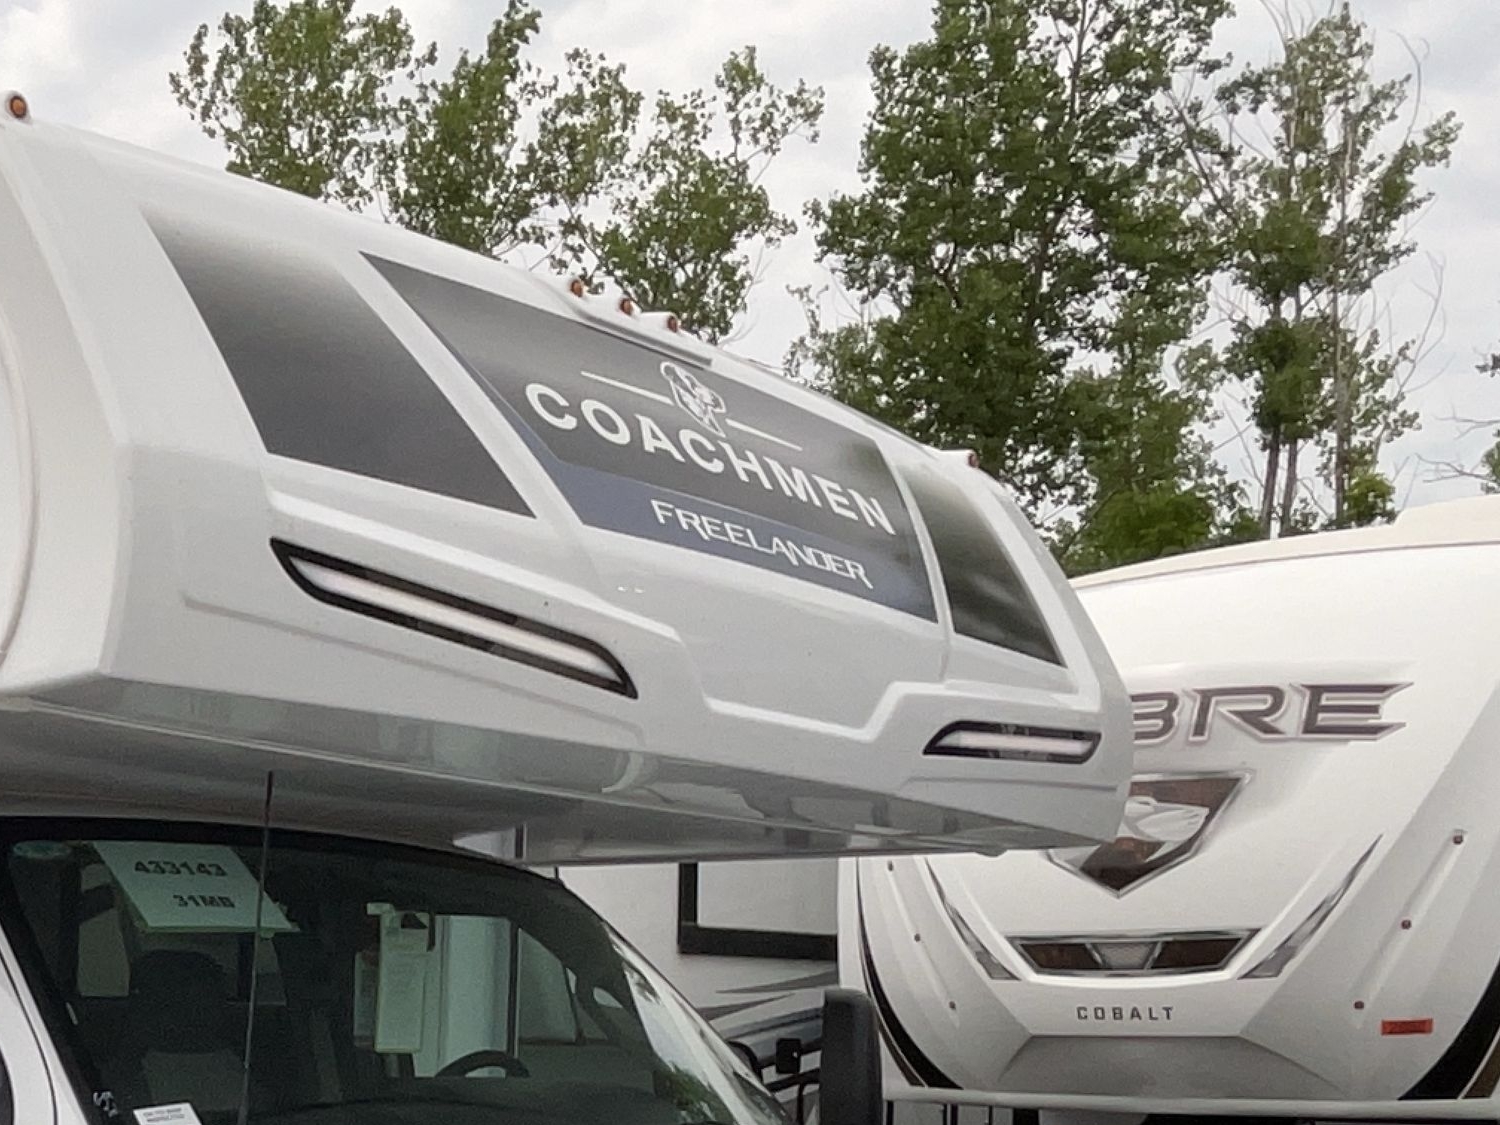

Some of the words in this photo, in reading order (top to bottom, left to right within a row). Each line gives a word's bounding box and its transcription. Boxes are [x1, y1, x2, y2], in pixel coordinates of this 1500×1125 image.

[525, 382, 896, 535] COACHMEN
[651, 499, 874, 588] FREELANDER
[134, 860, 228, 877] 433143
[172, 894, 236, 908] 31MB
[1076, 1006, 1174, 1020] COBALT
